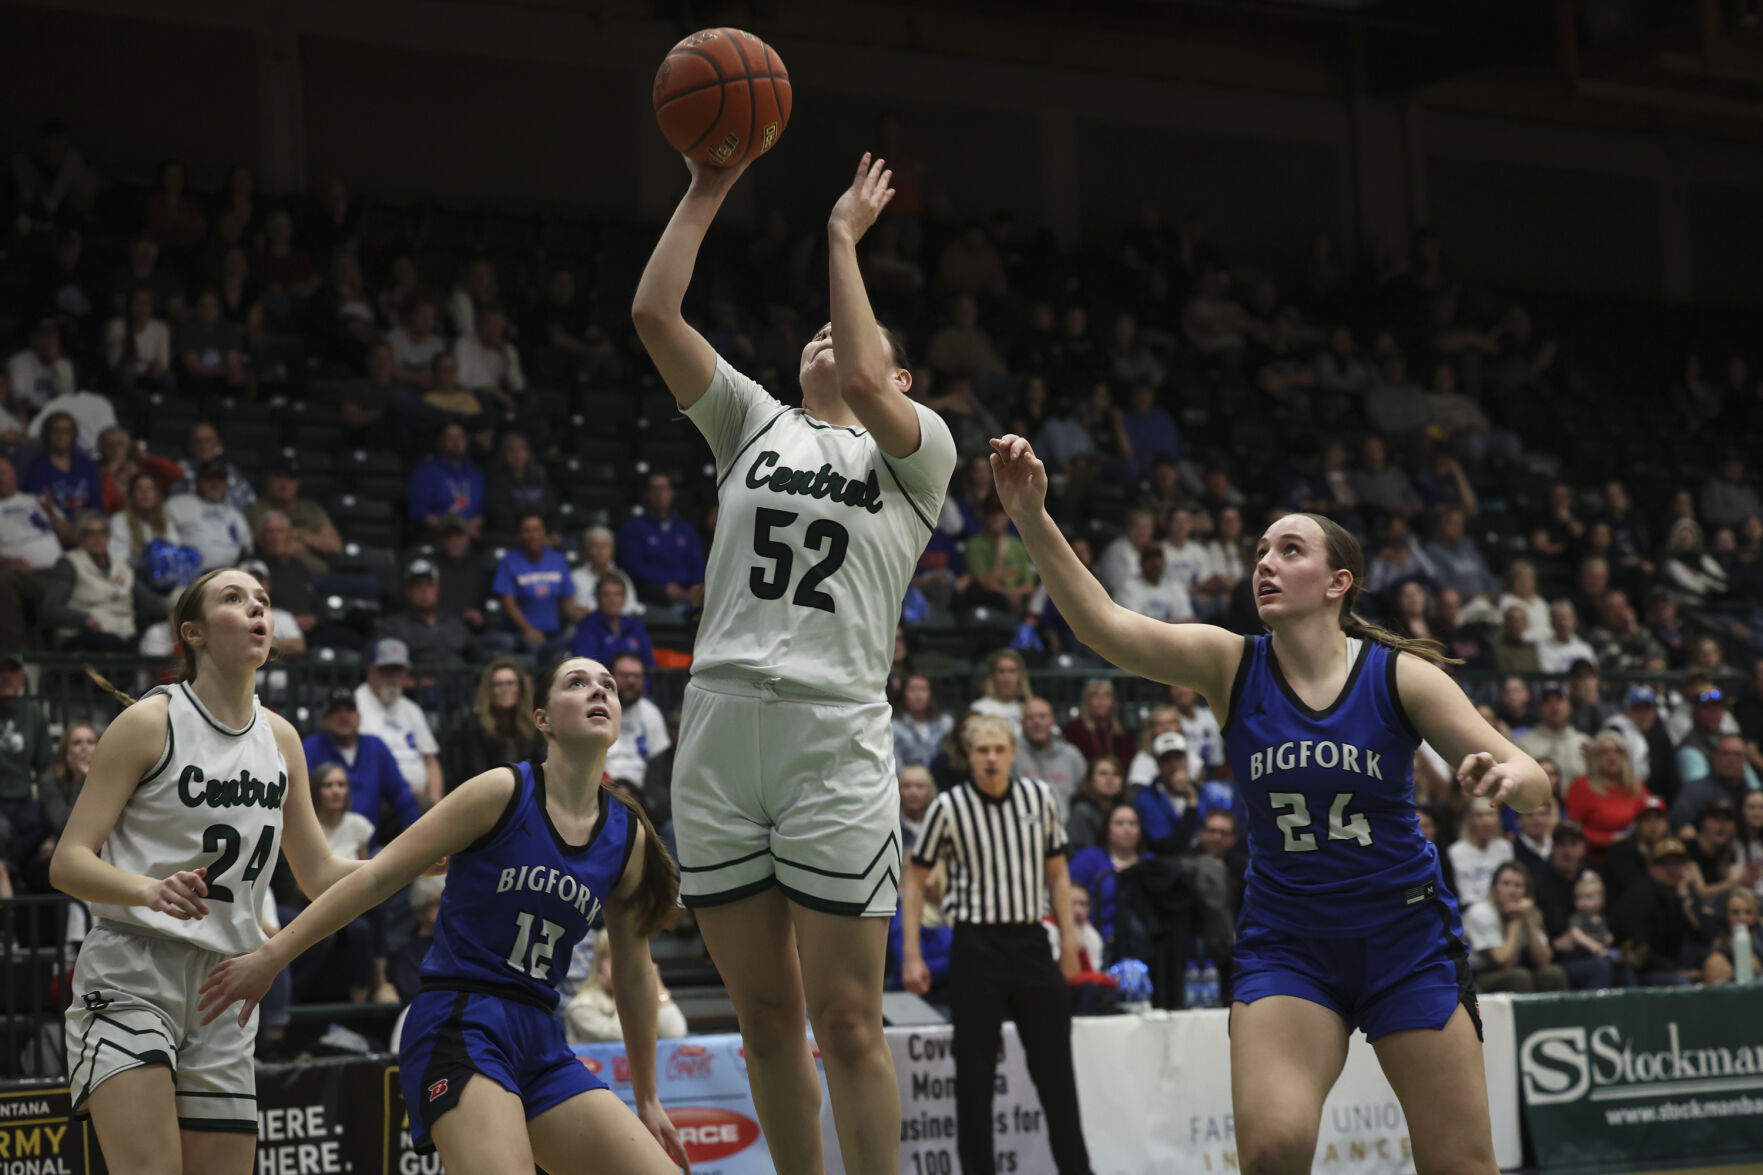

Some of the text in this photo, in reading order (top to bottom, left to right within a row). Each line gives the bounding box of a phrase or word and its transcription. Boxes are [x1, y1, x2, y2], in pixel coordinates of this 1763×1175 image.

[745, 451, 883, 514] Central
[750, 507, 849, 613] 52
[178, 765, 287, 810] Central
[1250, 741, 1383, 781] BIGFORK
[1269, 792, 1373, 852] 24
[199, 824, 275, 903] 24
[496, 866, 602, 926] BIGFORK
[506, 911, 566, 980] 12
[912, 1072, 1007, 1101] Mona
[1014, 1105, 1041, 1133] for
[912, 1149, 952, 1175] 100
